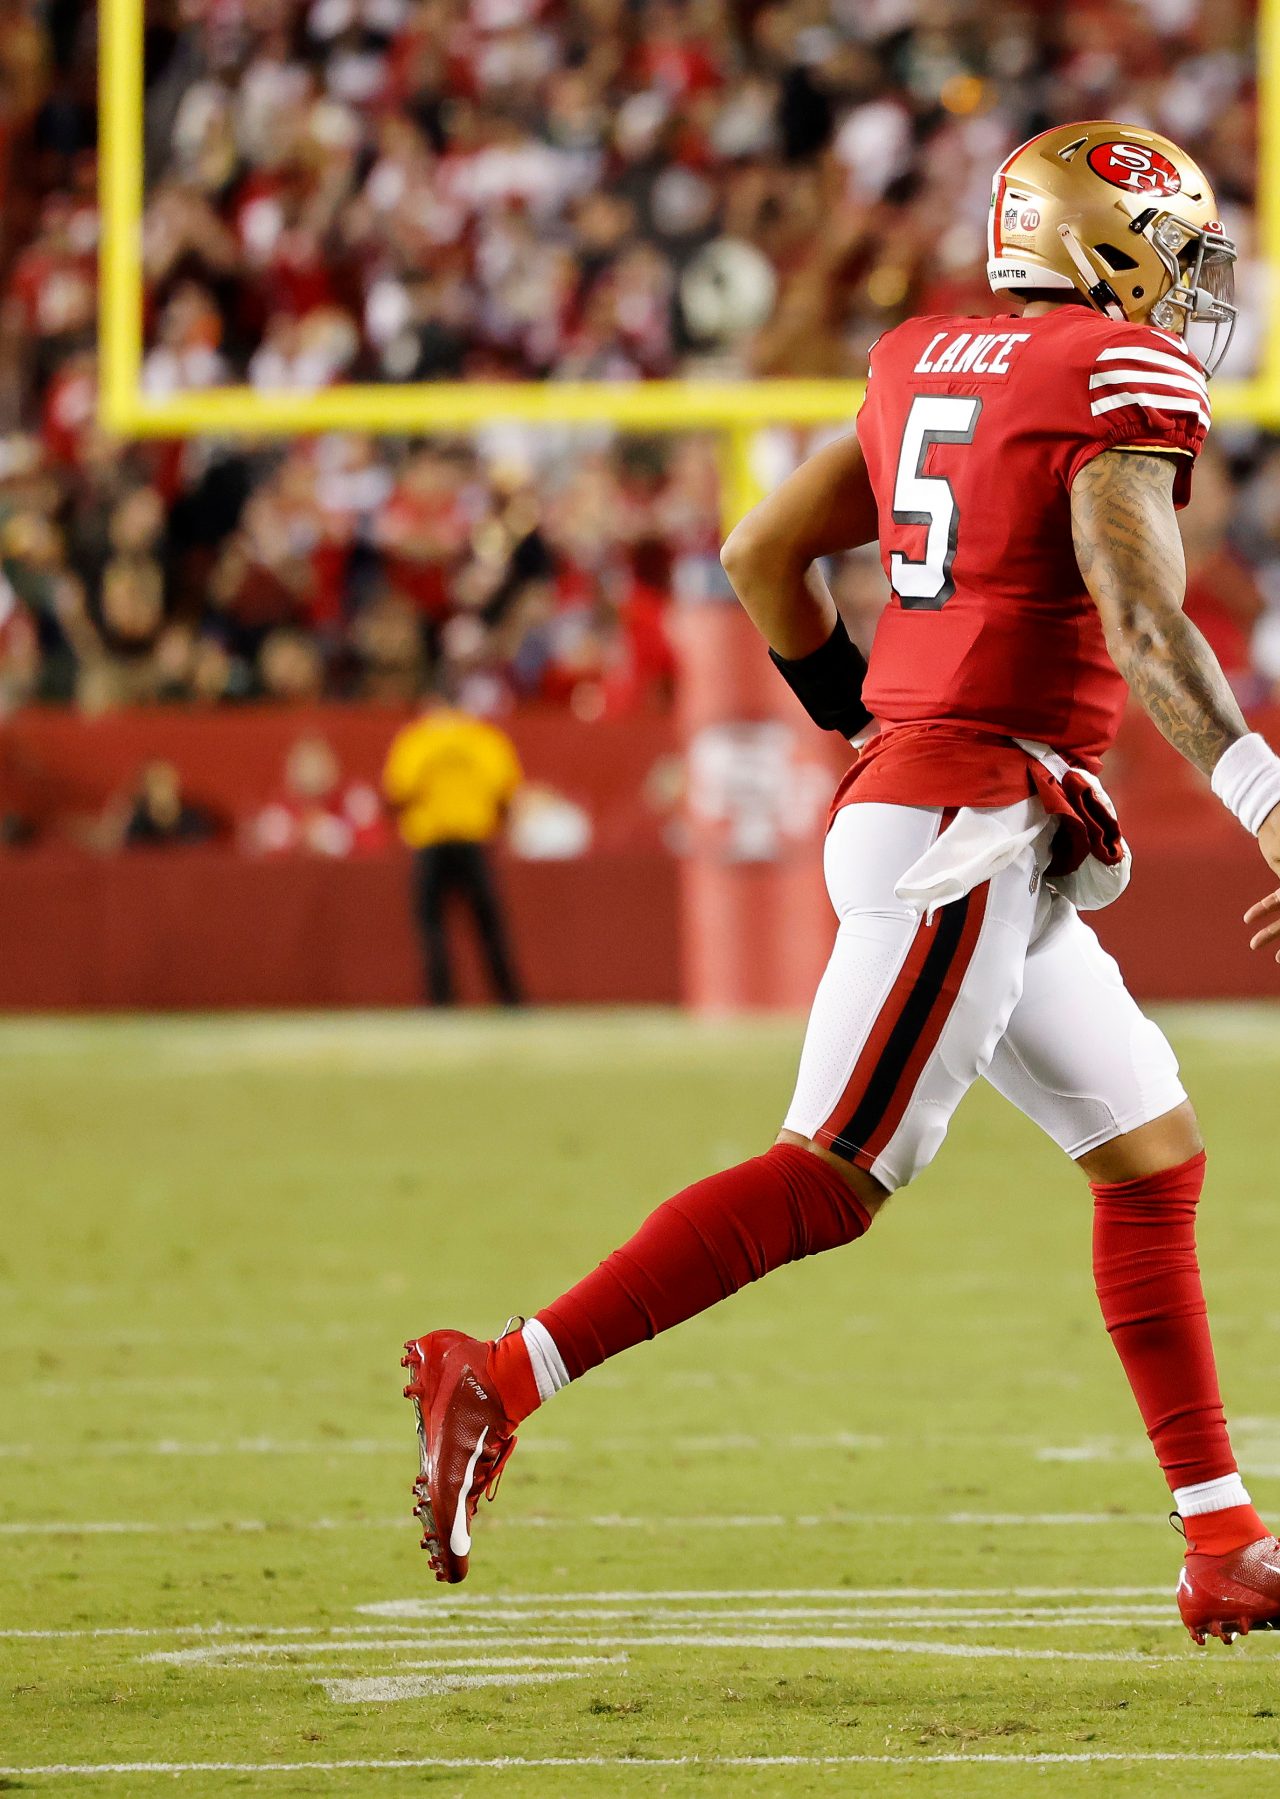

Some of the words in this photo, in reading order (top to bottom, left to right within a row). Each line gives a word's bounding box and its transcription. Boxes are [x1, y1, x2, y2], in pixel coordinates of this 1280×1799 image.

[997, 269, 1026, 279] MATTER
[914, 332, 1031, 375] LANCE
[889, 394, 982, 610] 5
[466, 1376, 488, 1401] VAPOR
